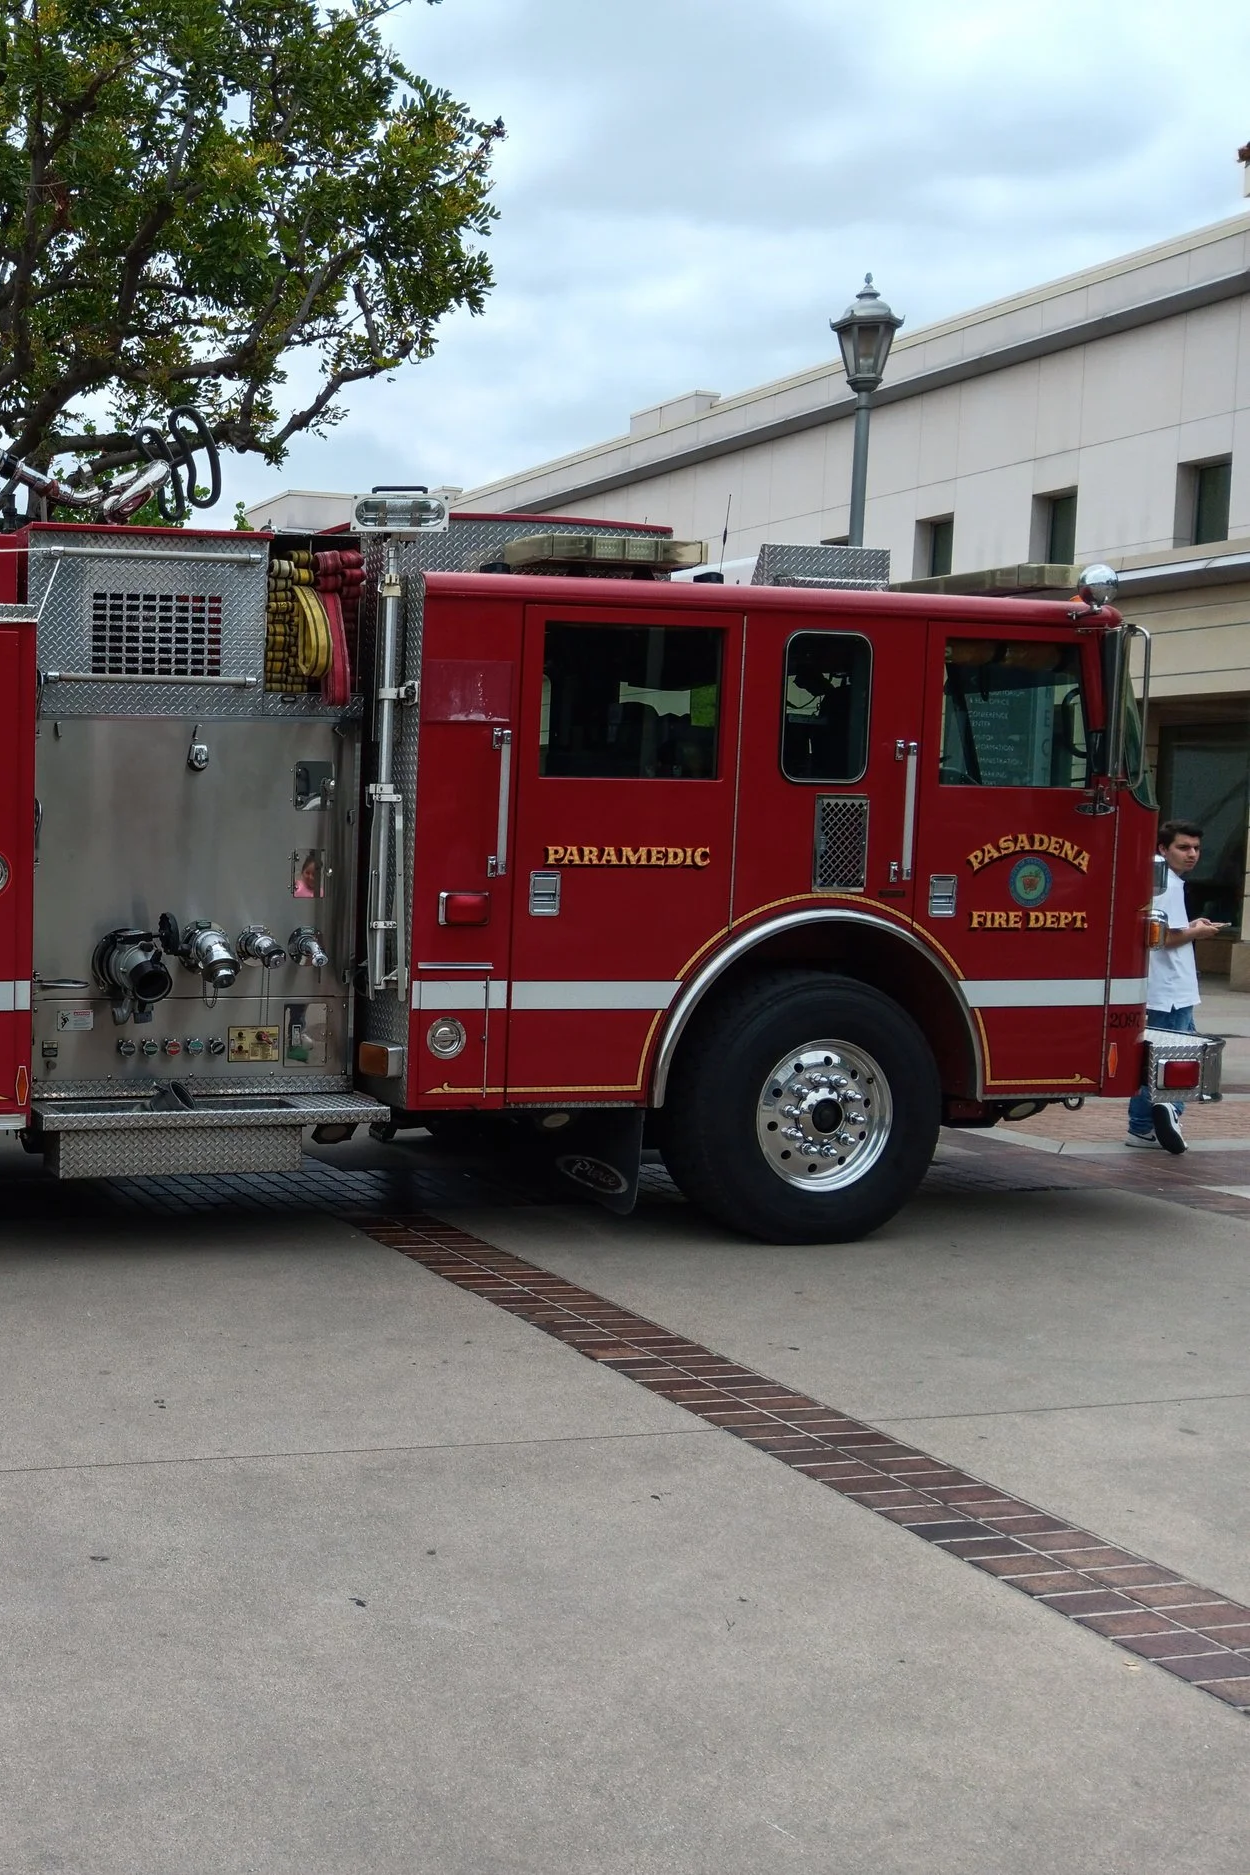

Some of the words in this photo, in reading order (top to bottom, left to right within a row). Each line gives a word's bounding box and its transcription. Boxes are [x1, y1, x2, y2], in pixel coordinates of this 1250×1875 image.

[543, 845, 711, 869] PARAMEDIC
[966, 832, 1091, 875] PASADENA
[968, 910, 1023, 930] FIRE
[1026, 910, 1088, 930] DEPT.
